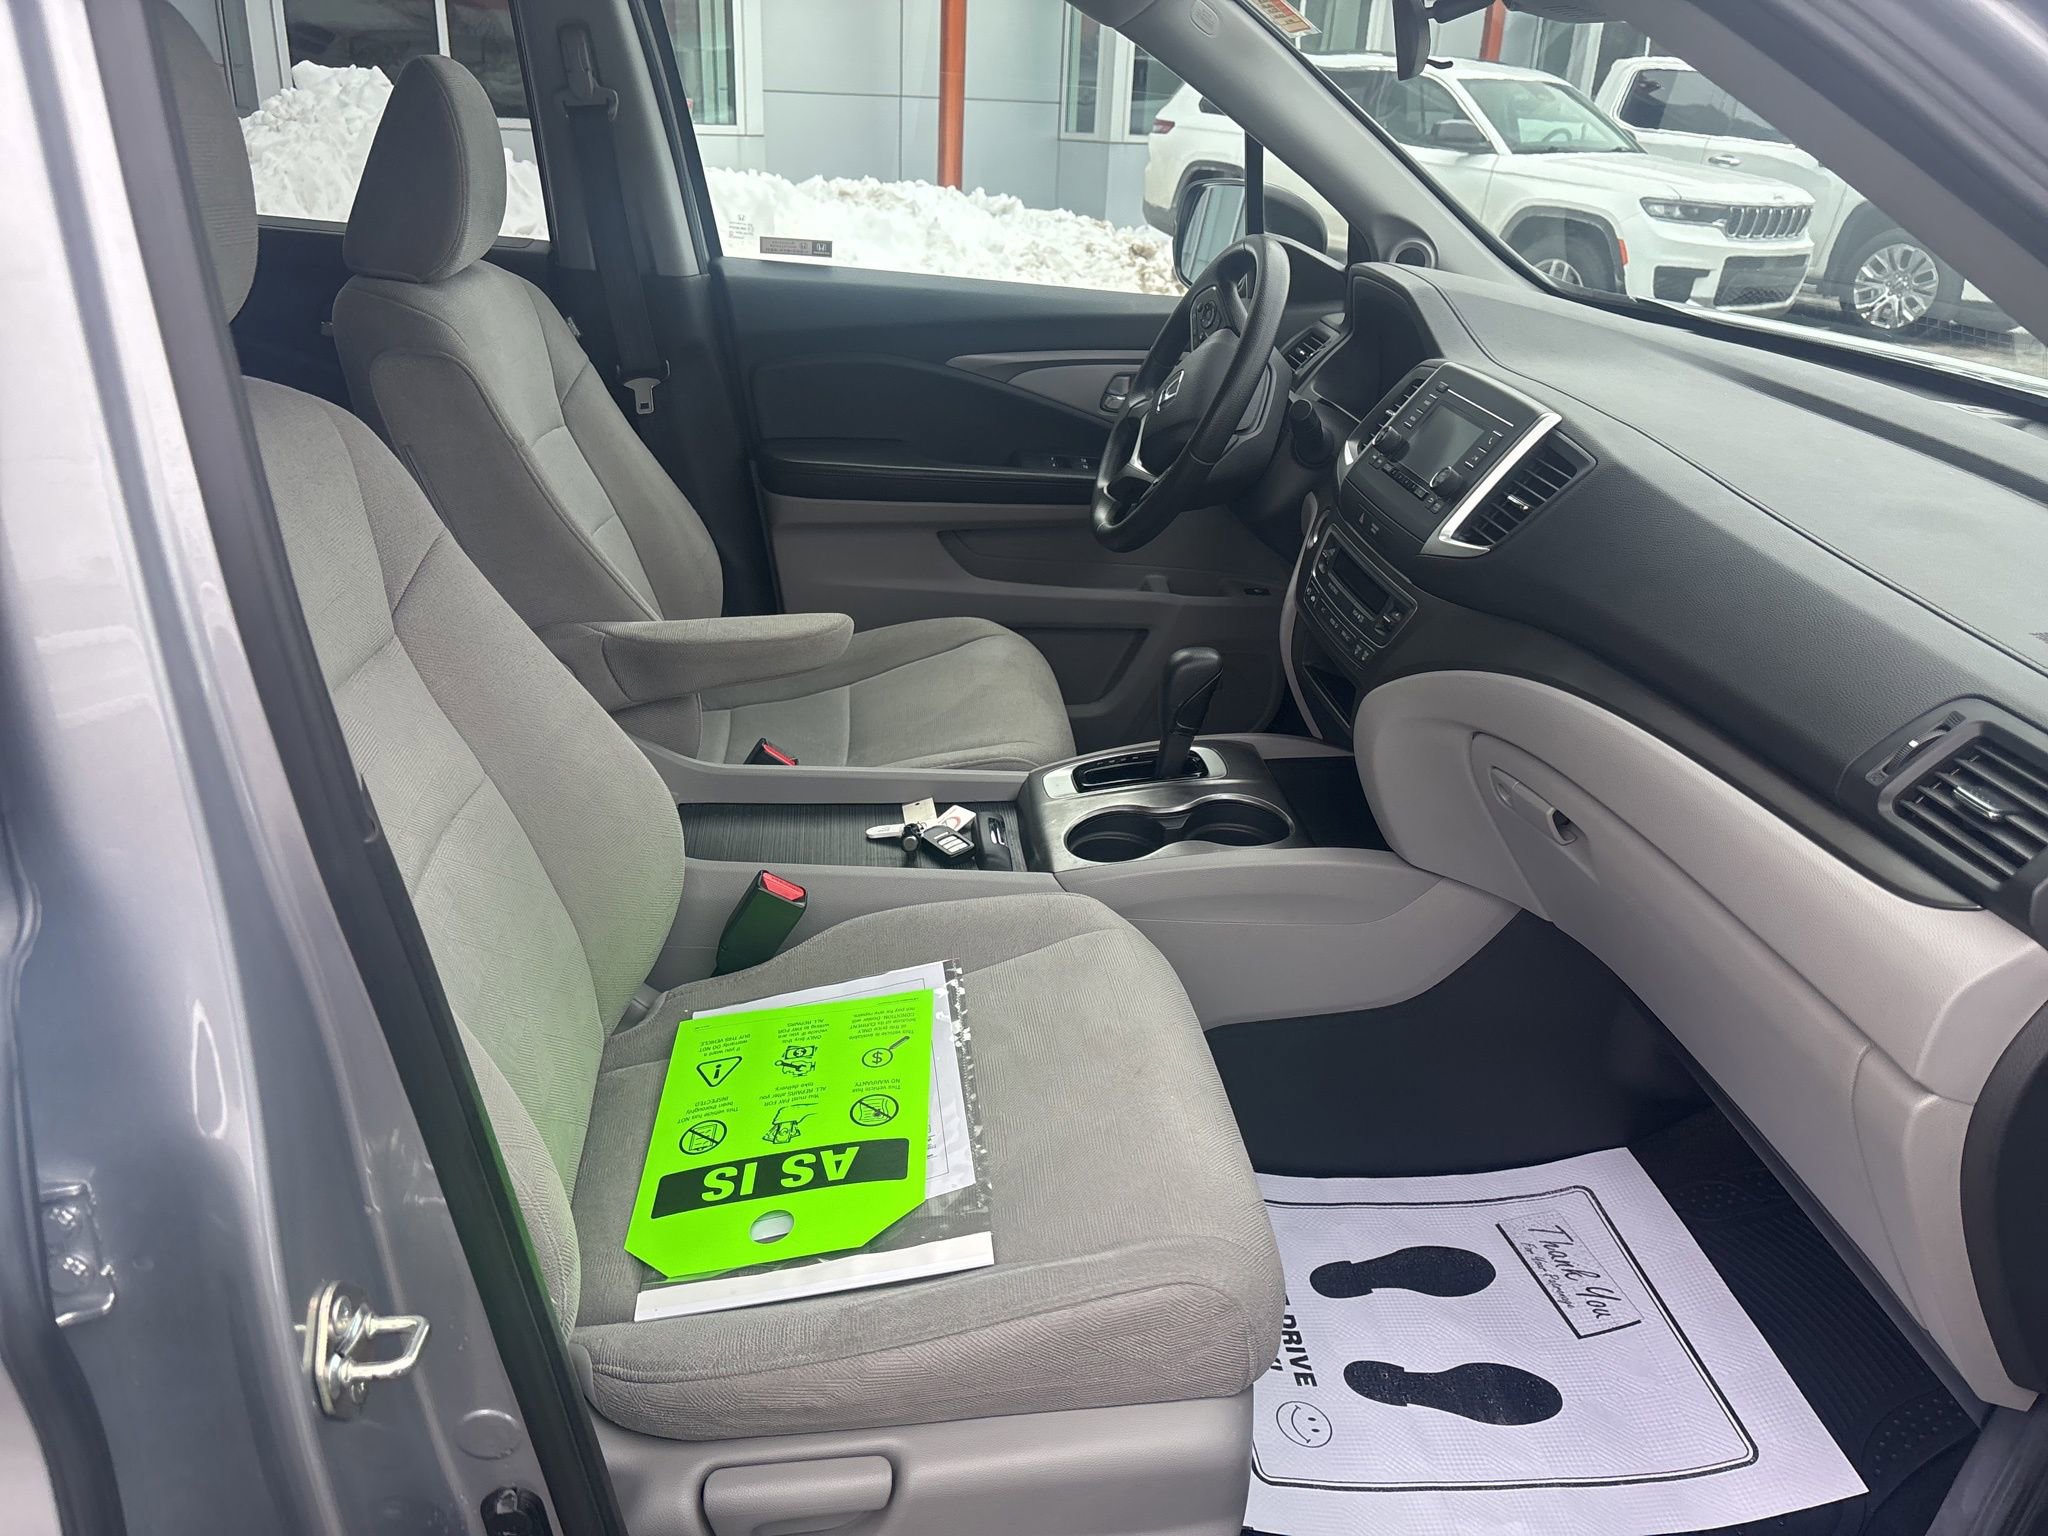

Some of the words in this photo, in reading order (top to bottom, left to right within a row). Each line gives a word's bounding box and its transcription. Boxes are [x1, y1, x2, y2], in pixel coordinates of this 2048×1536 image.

[849, 1022, 876, 1030] CURRENT
[787, 1088, 813, 1096] REPAIRS
[677, 1116, 691, 1124] NOT
[701, 1161, 758, 1202] IS
[780, 1146, 860, 1188] AS
[1527, 1224, 1601, 1281] Thank
[1576, 1286, 1622, 1319] You
[1281, 1314, 1318, 1387] DRIVE
